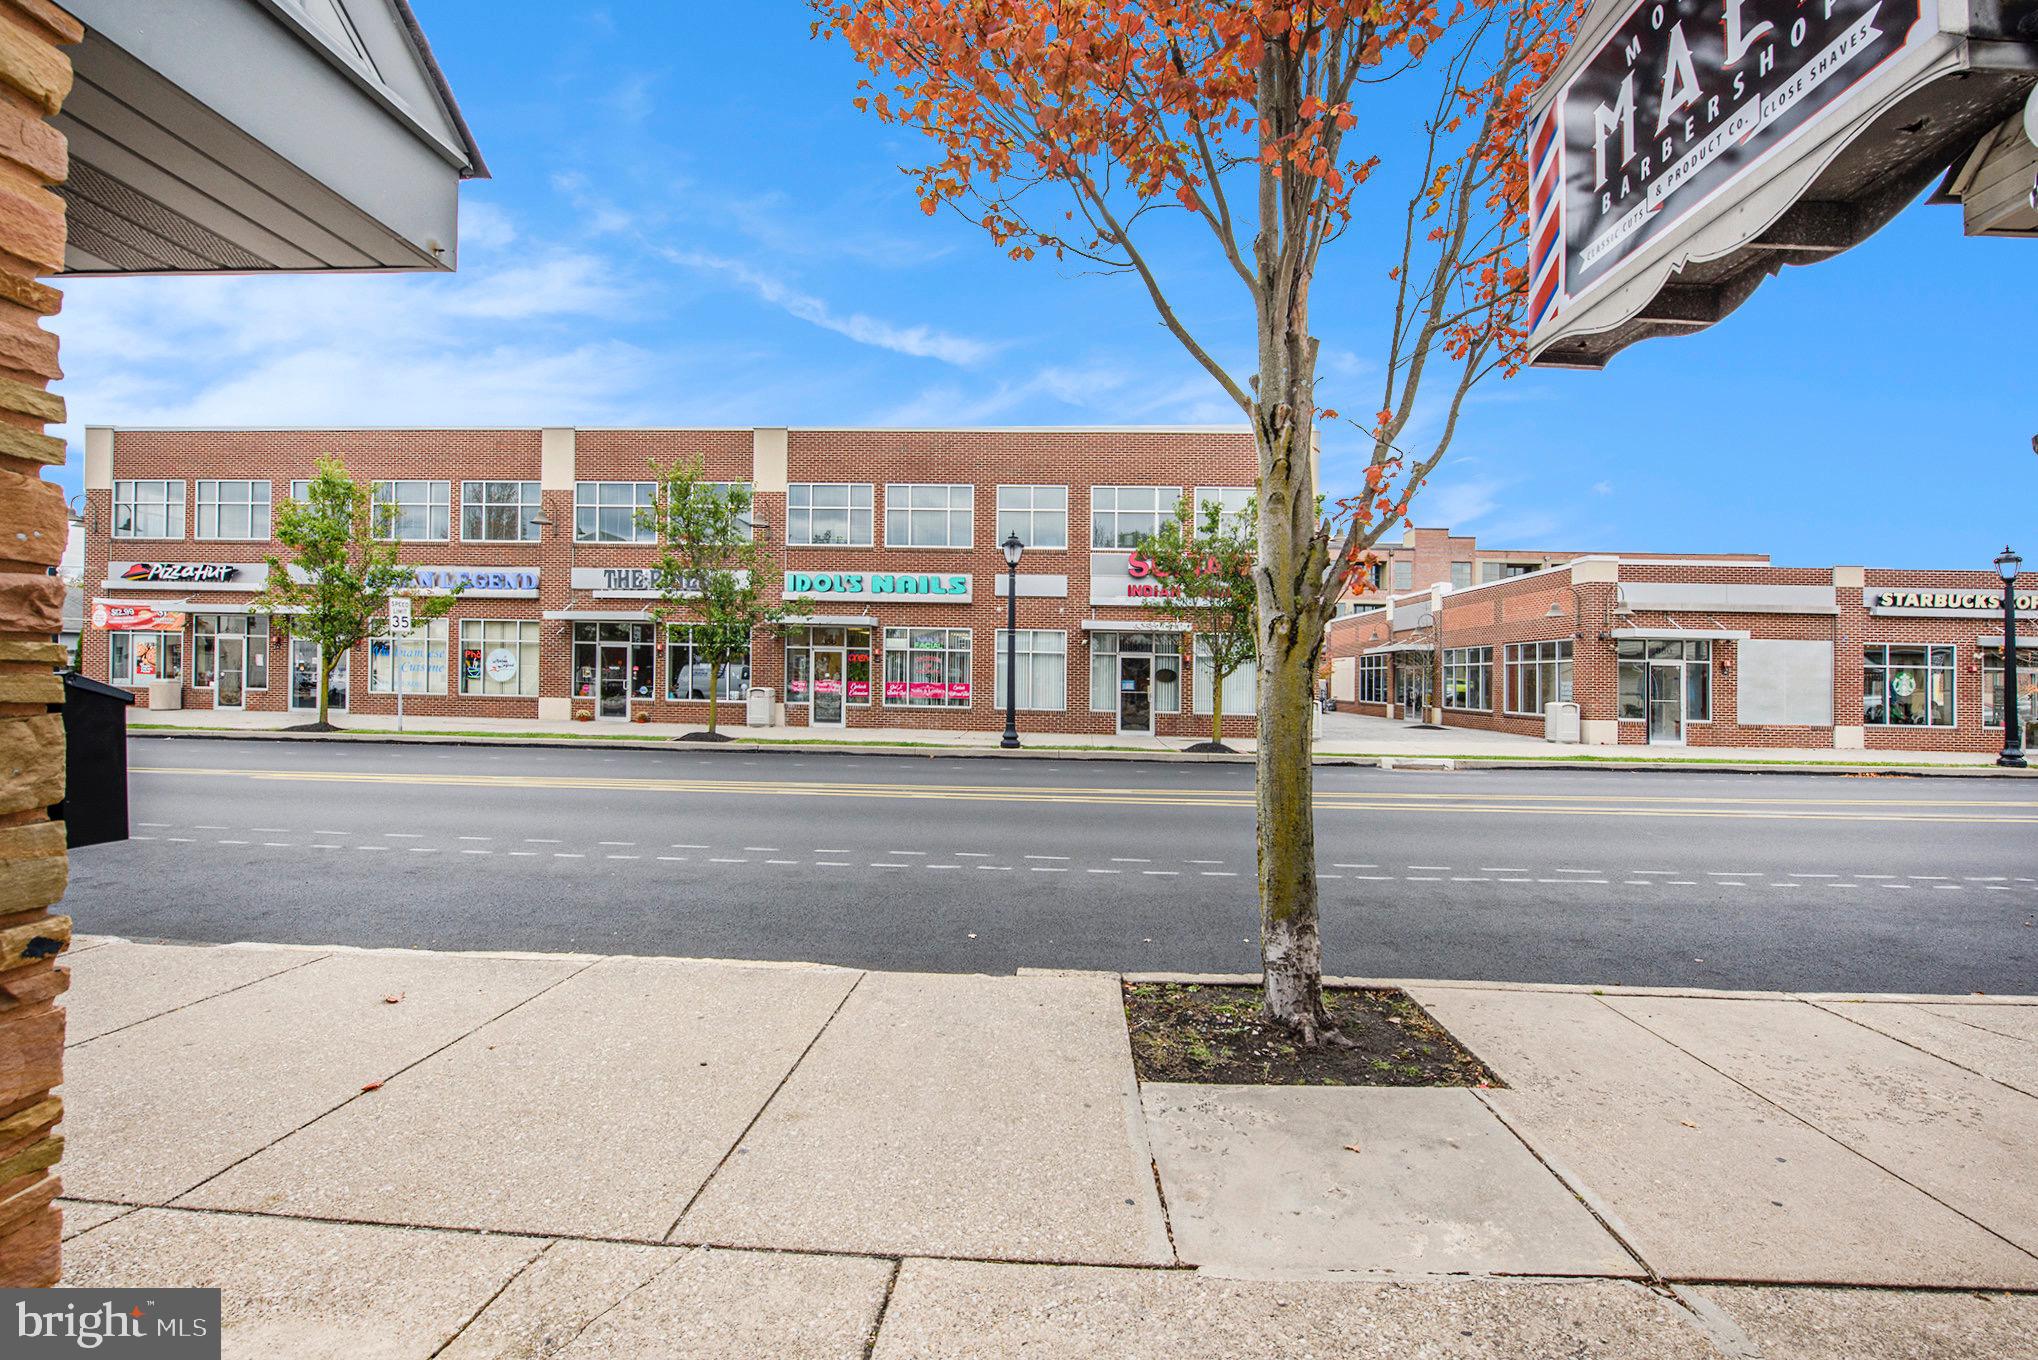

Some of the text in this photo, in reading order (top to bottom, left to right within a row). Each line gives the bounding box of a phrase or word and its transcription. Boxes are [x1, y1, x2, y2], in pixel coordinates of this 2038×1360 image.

[1625, 0, 1683, 67] MO
[1601, 0, 1838, 215] BARBERSHOP
[1586, 25, 1869, 262] CLASSIC CUTS & PRODUCT CO. CLOSE SHAVES
[148, 563, 233, 581] Pizza Hut
[440, 571, 540, 590] LEGEND
[603, 569, 643, 589] THE
[787, 573, 967, 595] IDOL'S NAILS
[391, 600, 409, 608] SPEED
[1881, 592, 2038, 610] STARBUCKS OF
[392, 615, 409, 628] 35
